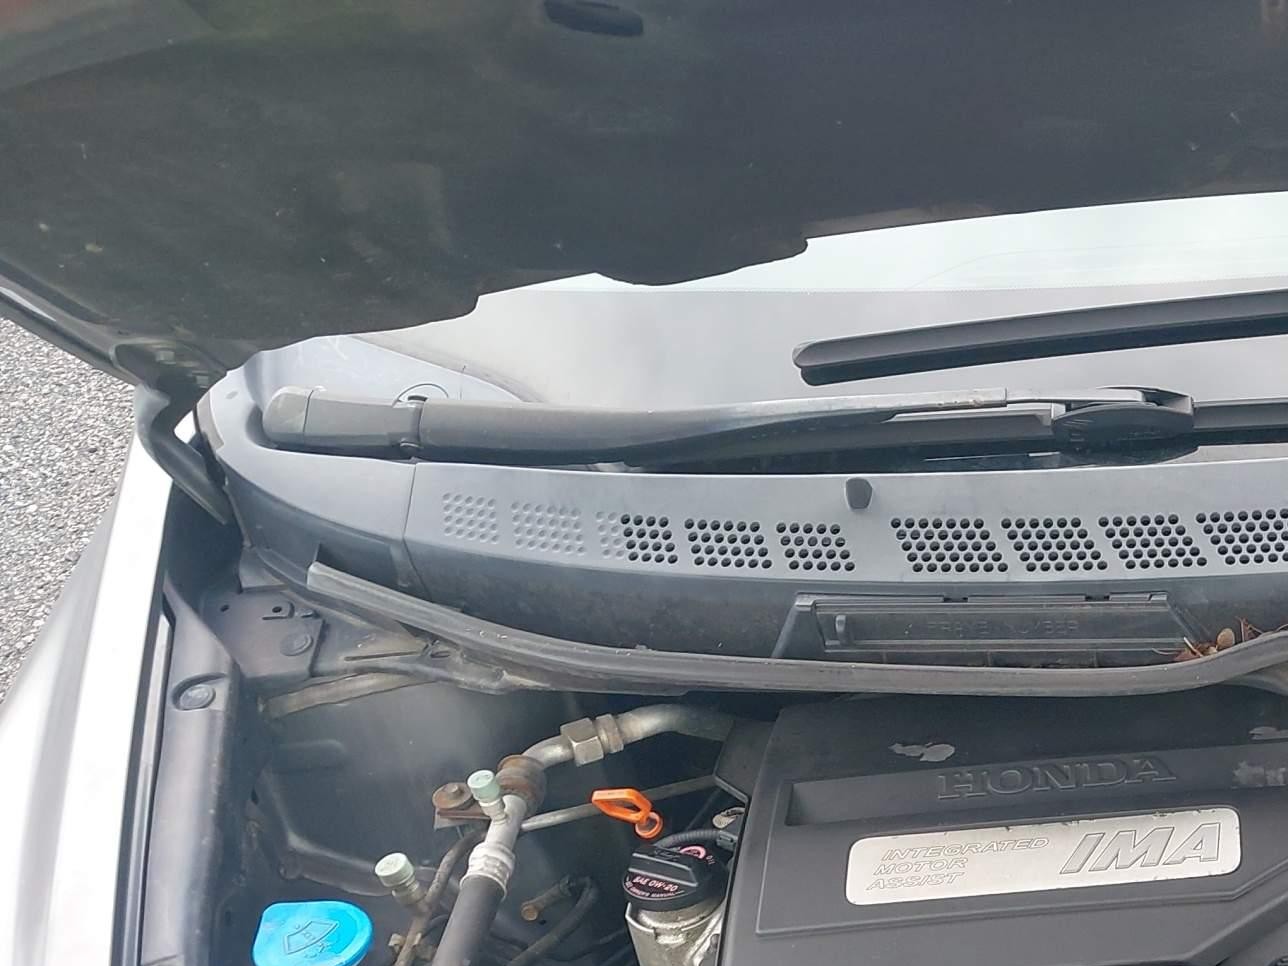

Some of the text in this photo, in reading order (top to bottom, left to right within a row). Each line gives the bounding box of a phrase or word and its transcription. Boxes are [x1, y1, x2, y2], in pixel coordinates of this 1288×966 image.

[938, 756, 1176, 800] HONDA
[882, 837, 1049, 861] INTEGRATED
[1059, 822, 1222, 875] IMA
[873, 857, 968, 876] MOTOR
[649, 880, 679, 892] 0W-20
[865, 872, 965, 891] ASSIST
